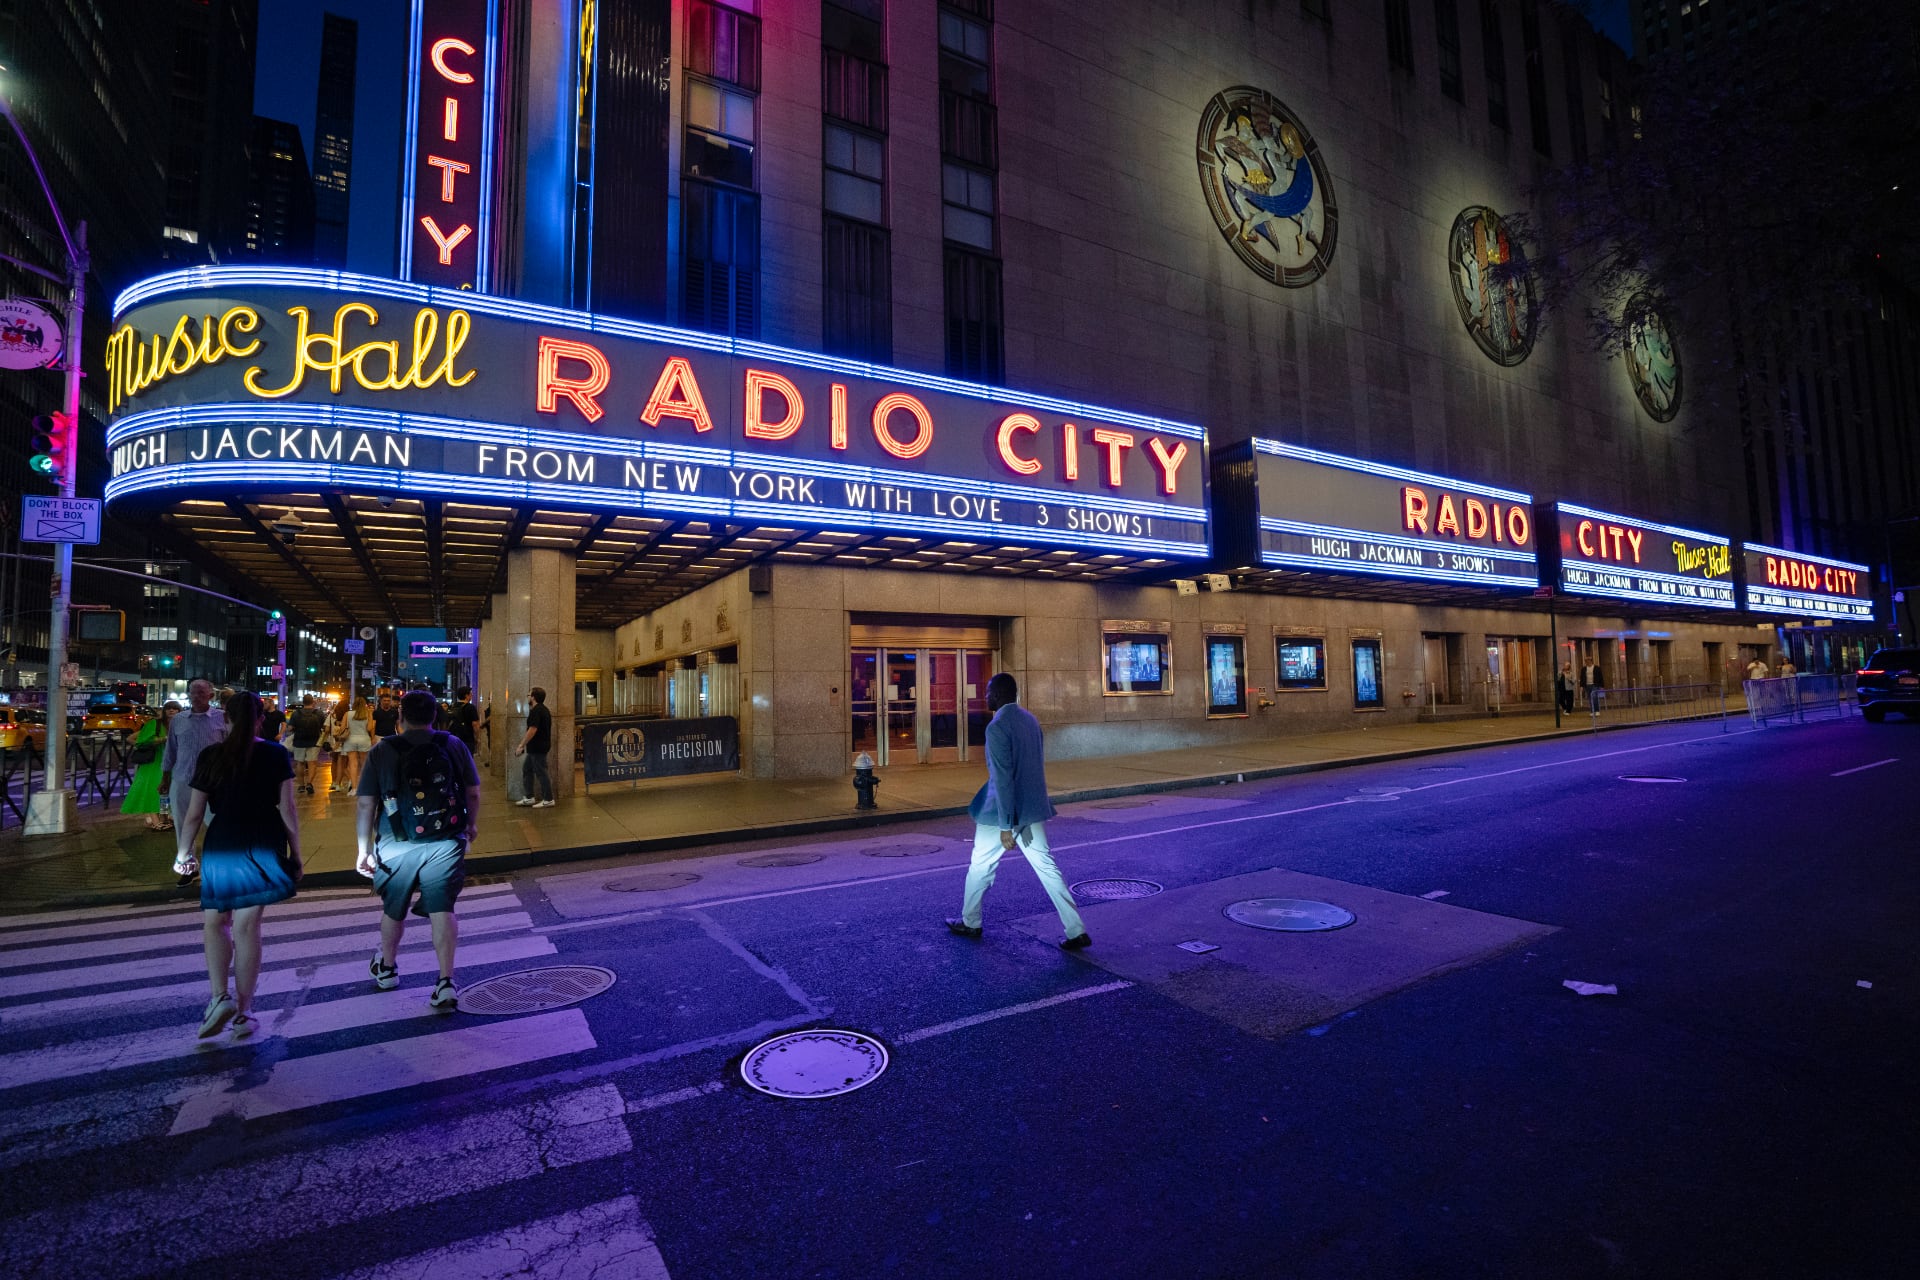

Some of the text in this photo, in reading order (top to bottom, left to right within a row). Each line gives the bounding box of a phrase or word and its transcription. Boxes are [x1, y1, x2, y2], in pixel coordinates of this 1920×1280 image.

[421, 37, 476, 266] CITY
[105, 302, 478, 414] Music Hall
[535, 335, 1188, 495] RADIO CITY
[112, 433, 167, 479] HUGH
[190, 426, 411, 468] JACKMAN
[478, 444, 595, 484] FROM
[624, 460, 701, 493] NEW
[844, 482, 913, 513] WITH
[933, 492, 1003, 523] LOVE
[1036, 504, 1050, 526] 3
[1067, 507, 1153, 538] SHOWS!
[28, 499, 95, 511] DON'T BLOCK
[40, 509, 83, 520] THE BOX
[1402, 486, 1530, 547] RADIO
[1311, 537, 1495, 574] HUGH JACKMAN 3 SHOWS!
[1577, 520, 1643, 564] CITY
[1672, 540, 1731, 579] Music Hall
[1566, 568, 1591, 585] HUGH
[1594, 572, 1632, 590] JACKMAN
[1638, 578, 1659, 593] FROM
[1661, 581, 1677, 595] NEW
[1699, 586, 1716, 599] WITH
[1715, 588, 1732, 601] LOVE
[1765, 556, 1858, 595] RADIO CITY
[422, 645, 452, 655] Subway
[256, 666, 294, 676] Hiln
[603, 728, 645, 764] 100
[661, 739, 722, 760] PRECISION
